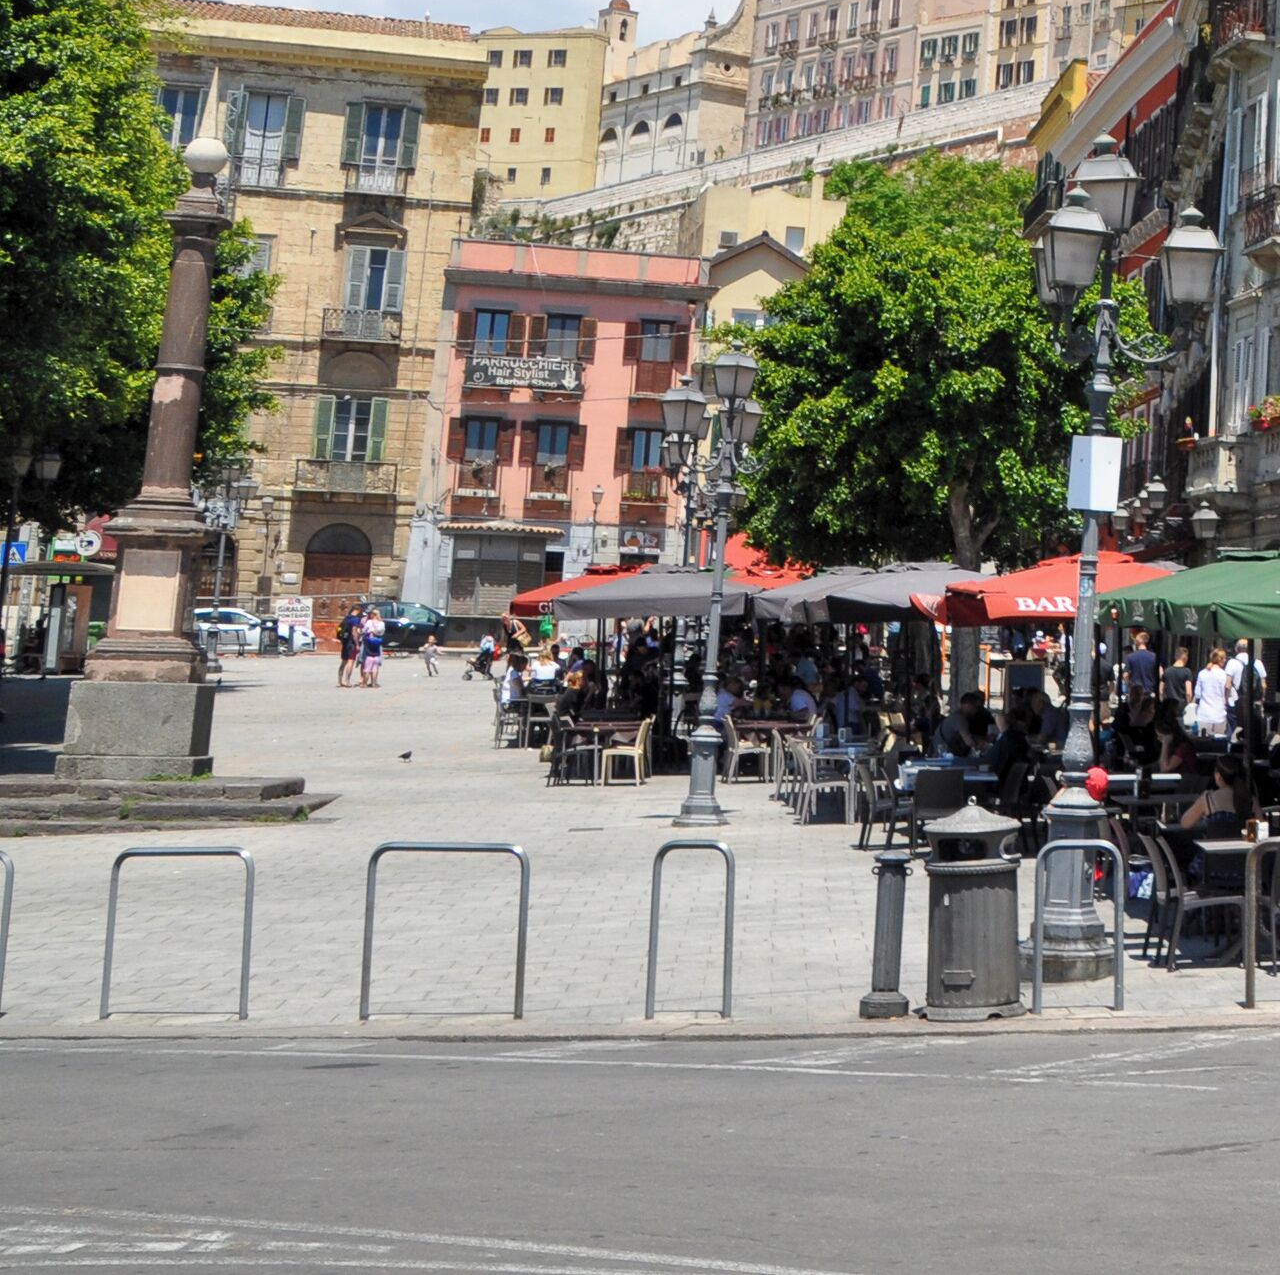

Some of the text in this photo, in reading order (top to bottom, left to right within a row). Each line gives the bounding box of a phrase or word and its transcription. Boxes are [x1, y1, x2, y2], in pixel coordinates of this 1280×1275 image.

[487, 366, 550, 379] Hair Stylist
[495, 376, 558, 388] Barber Shop
[1014, 596, 1077, 613] BAR
